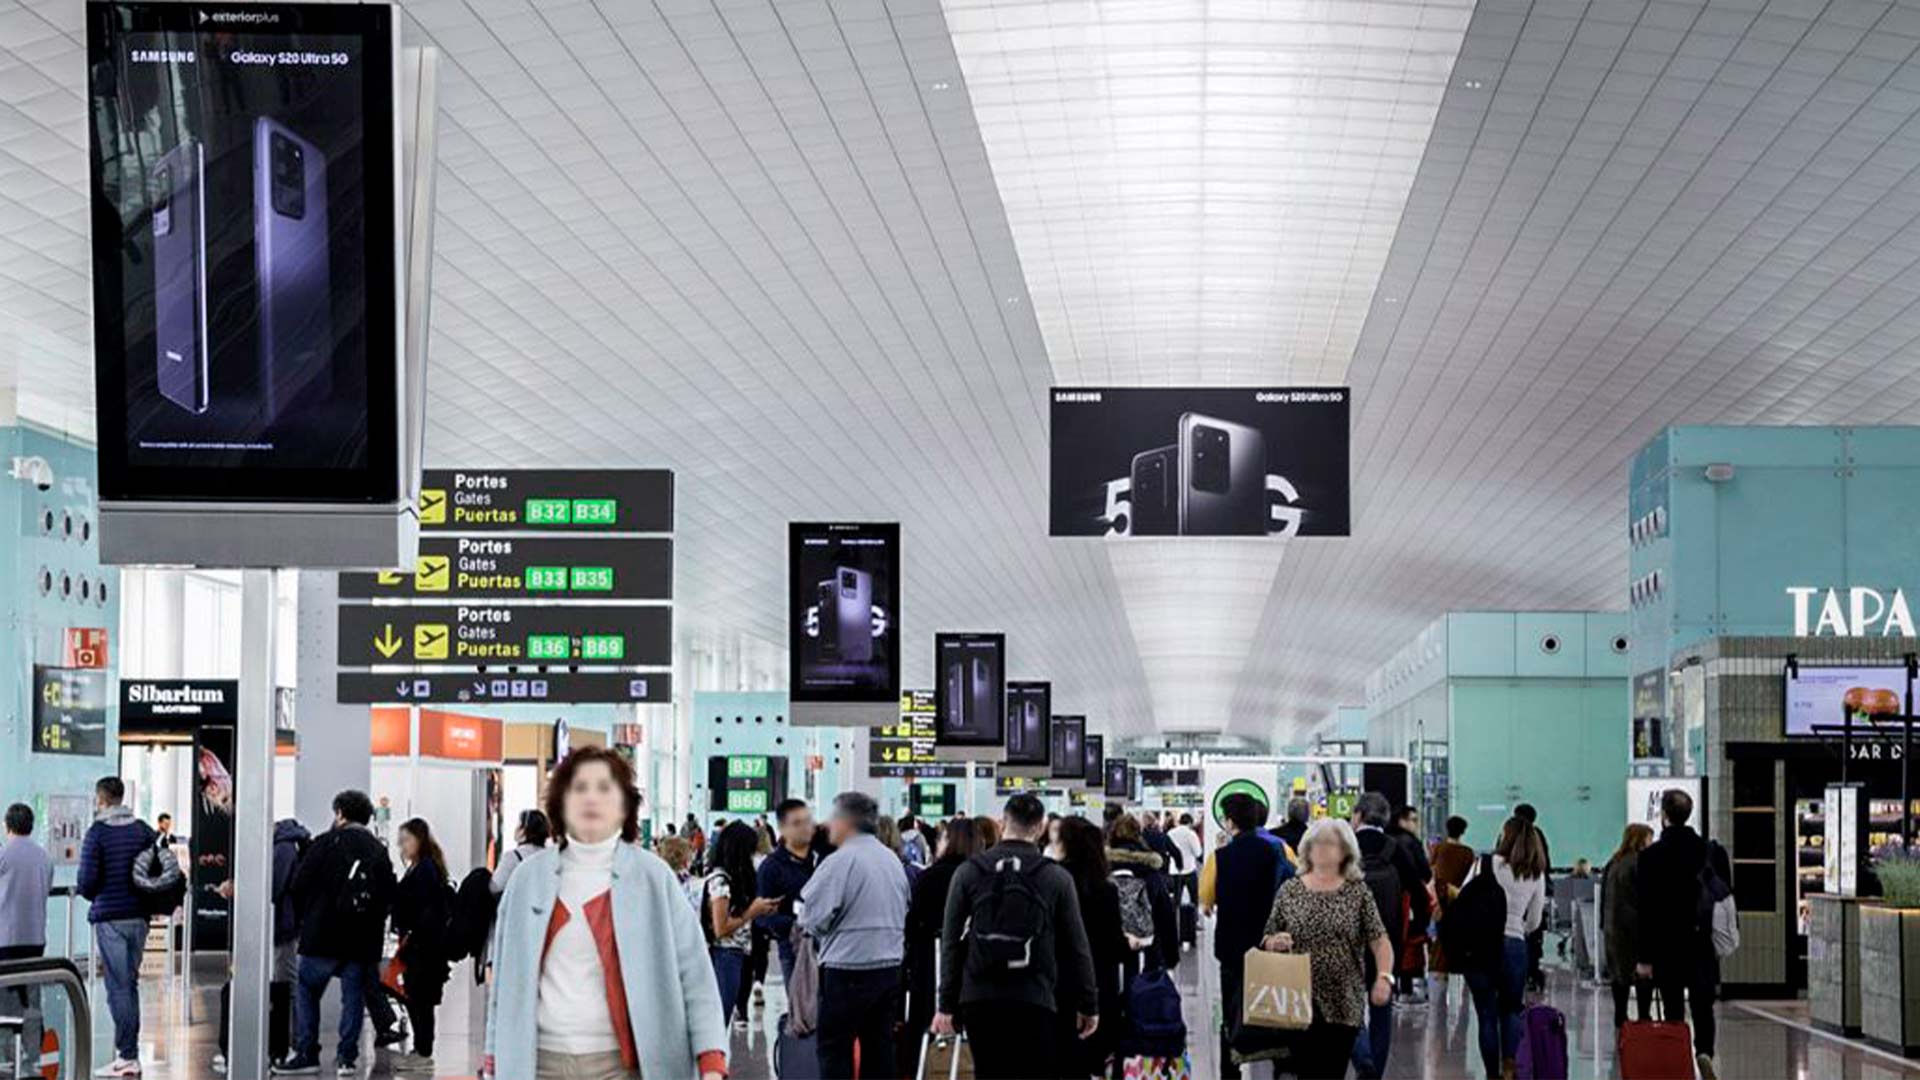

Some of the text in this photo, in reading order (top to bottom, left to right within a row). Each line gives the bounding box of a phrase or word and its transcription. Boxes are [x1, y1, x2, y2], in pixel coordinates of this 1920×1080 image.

[212, 11, 279, 23] exteriorplus
[132, 51, 195, 62] SAMSUNG
[231, 51, 348, 66] Galaxy S20 Ultra 5G
[1055, 392, 1102, 403] SAMSUNG
[455, 475, 507, 488] Portes
[455, 492, 492, 505] Gates
[455, 505, 611, 523] Puertas B32 B34
[459, 540, 512, 554] Portes
[459, 557, 497, 571] Gates
[458, 570, 609, 588] Puertas B33 B35
[459, 608, 511, 622] Portes
[1786, 586, 1917, 637] TAPA
[459, 626, 496, 639] Gates
[458, 643, 521, 657] Puertas
[532, 639, 564, 654] B36
[586, 639, 619, 654] B69
[128, 684, 224, 703] Sibarium
[733, 758, 763, 773] B37
